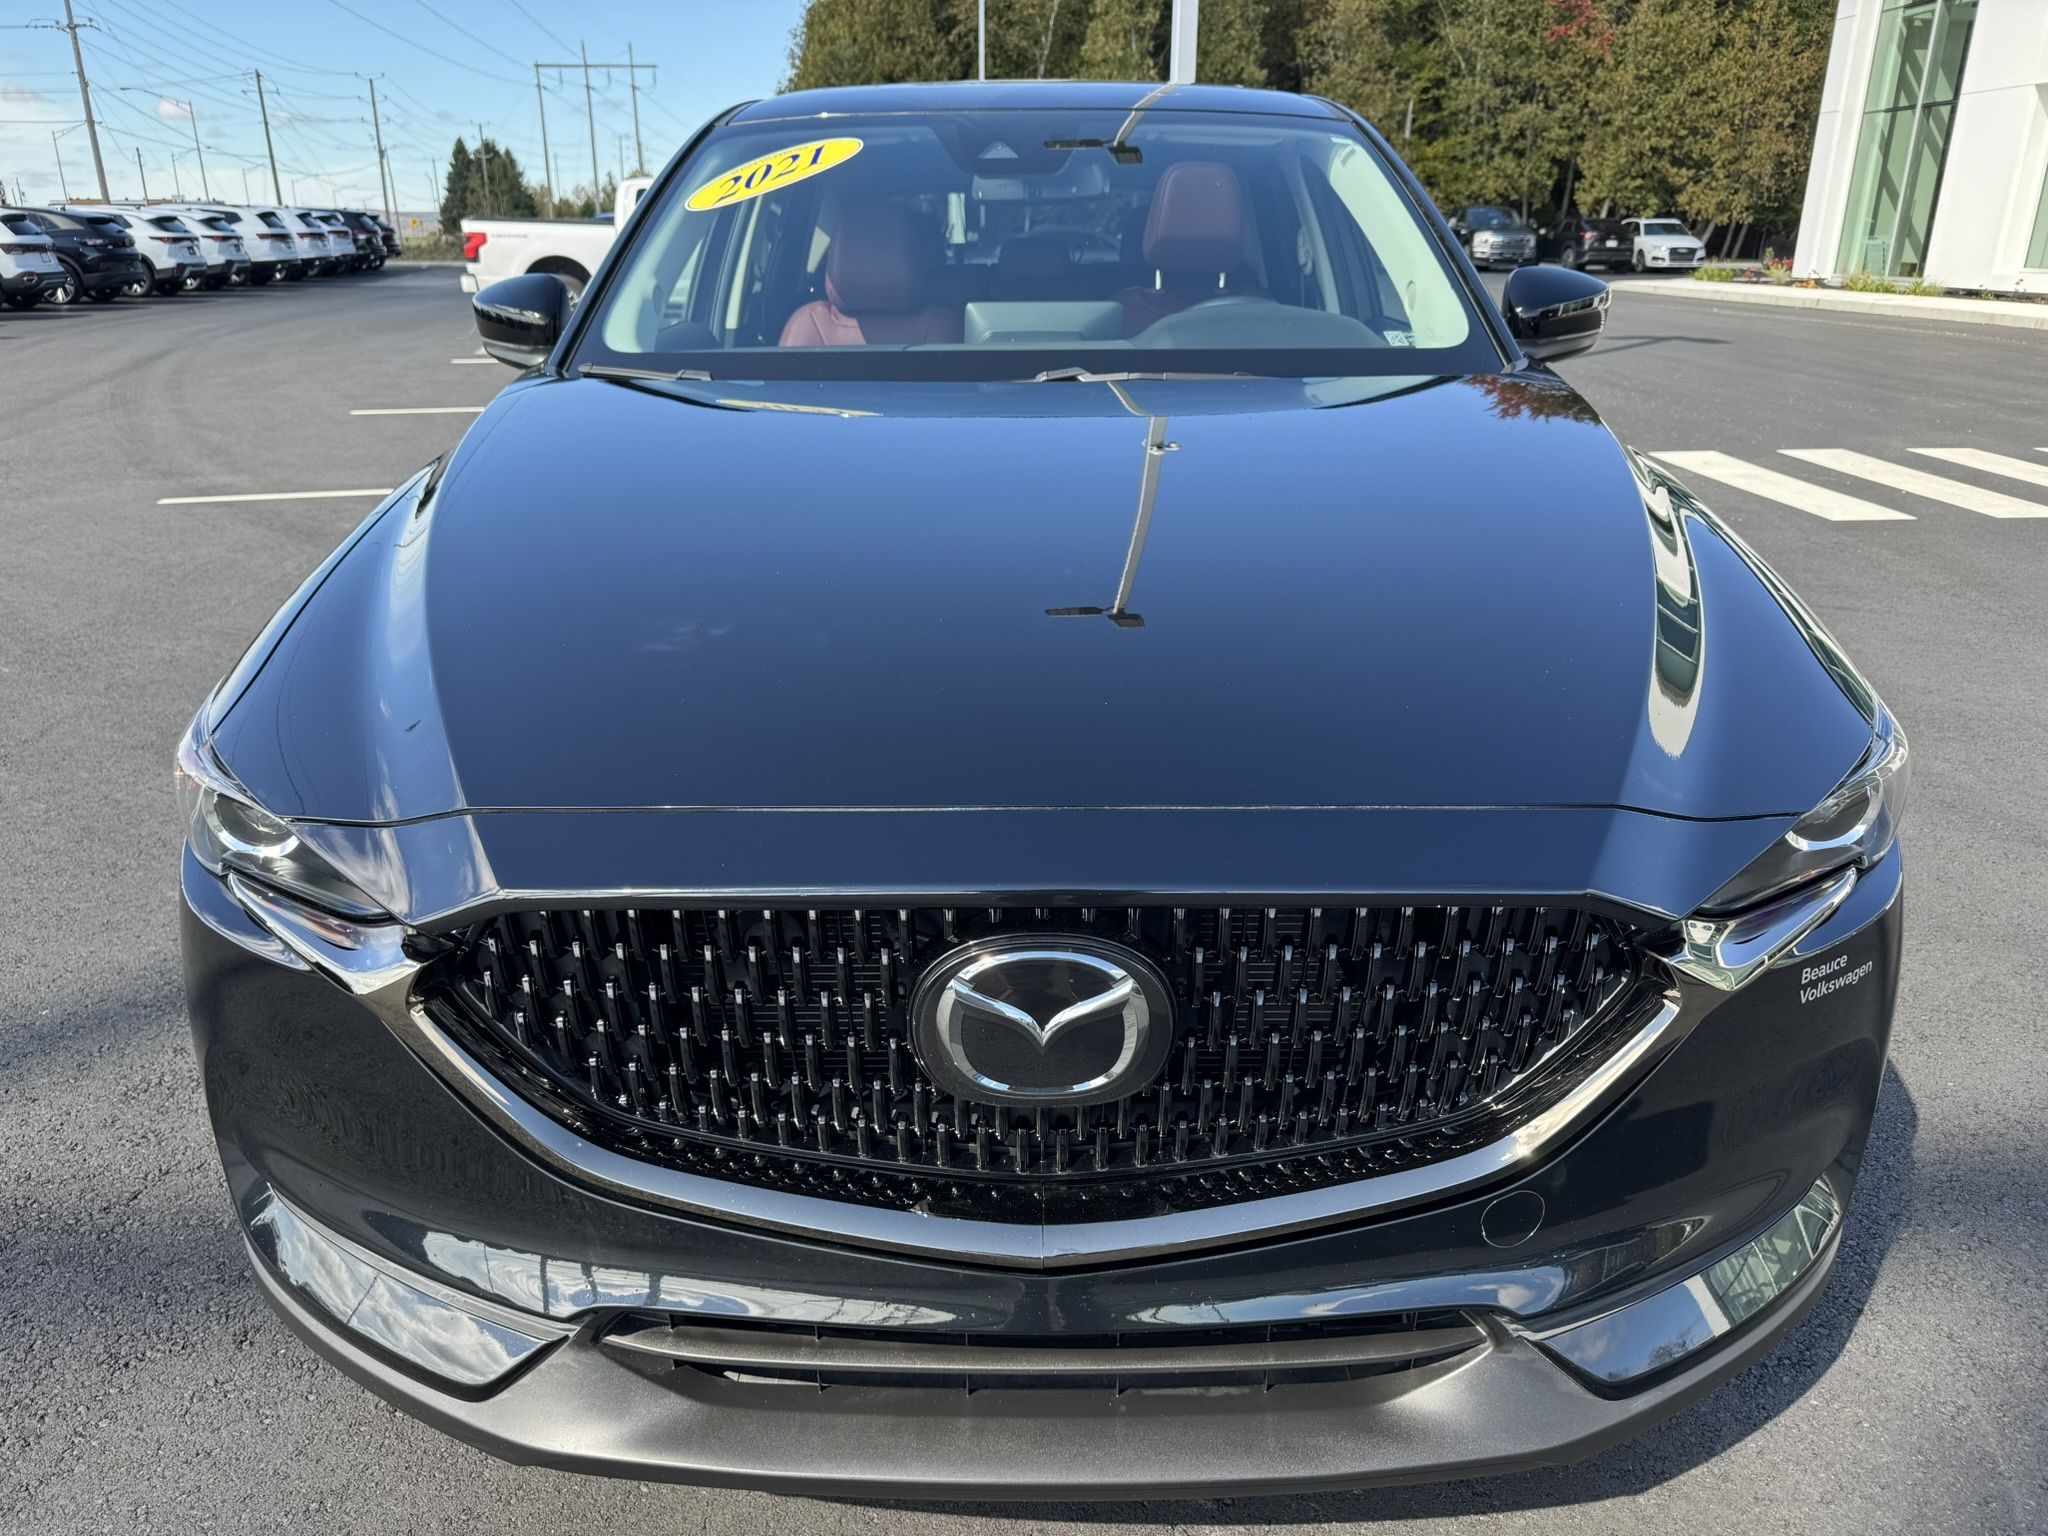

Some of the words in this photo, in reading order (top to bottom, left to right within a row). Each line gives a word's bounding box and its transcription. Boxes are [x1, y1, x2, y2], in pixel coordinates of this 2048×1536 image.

[713, 145, 825, 204] 2021
[1800, 961, 1873, 1004] Volkswagen
[1801, 955, 1848, 984] Beauce
